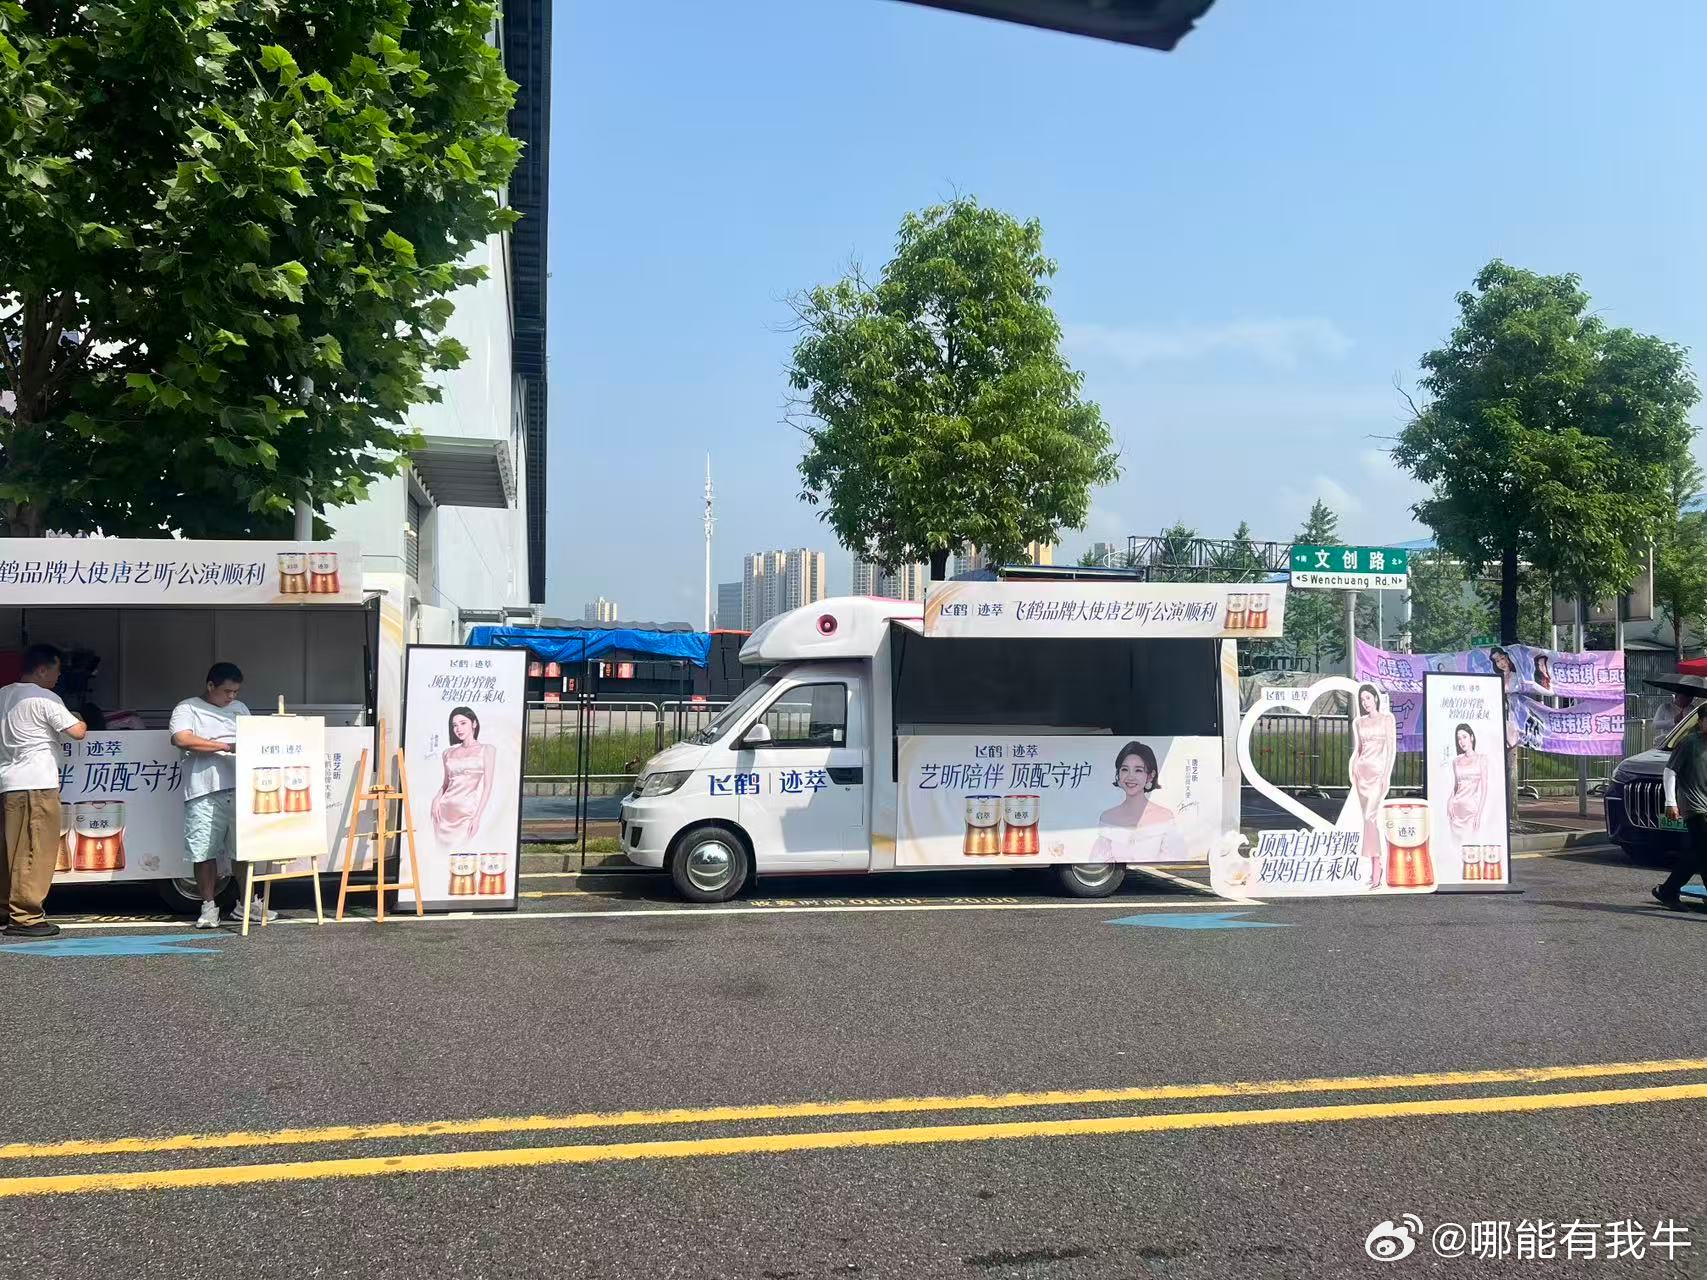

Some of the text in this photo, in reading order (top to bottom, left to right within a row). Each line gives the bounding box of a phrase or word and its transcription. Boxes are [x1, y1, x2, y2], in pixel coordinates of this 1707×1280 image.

[1315, 549, 1385, 570] 文创路
[1311, 575, 1369, 588] Wenchuang
[1375, 577, 1390, 586] Rd.
[940, 603, 968, 617] 飞鹤
[977, 603, 1004, 617] 迹萃
[1013, 601, 1218, 630] 飞鹤品牌大使唐艺昕公演顺利
[86, 741, 122, 757] 迹萃
[975, 744, 1039, 758] 飞鹤 迹萃
[708, 769, 828, 796] 飞鹤 迹萃
[919, 761, 1092, 789] 艺昕陪伴 顶配守护
[1252, 831, 1360, 858] 顶配自护撑腰
[1257, 857, 1362, 884] 妈妈自在乘风
